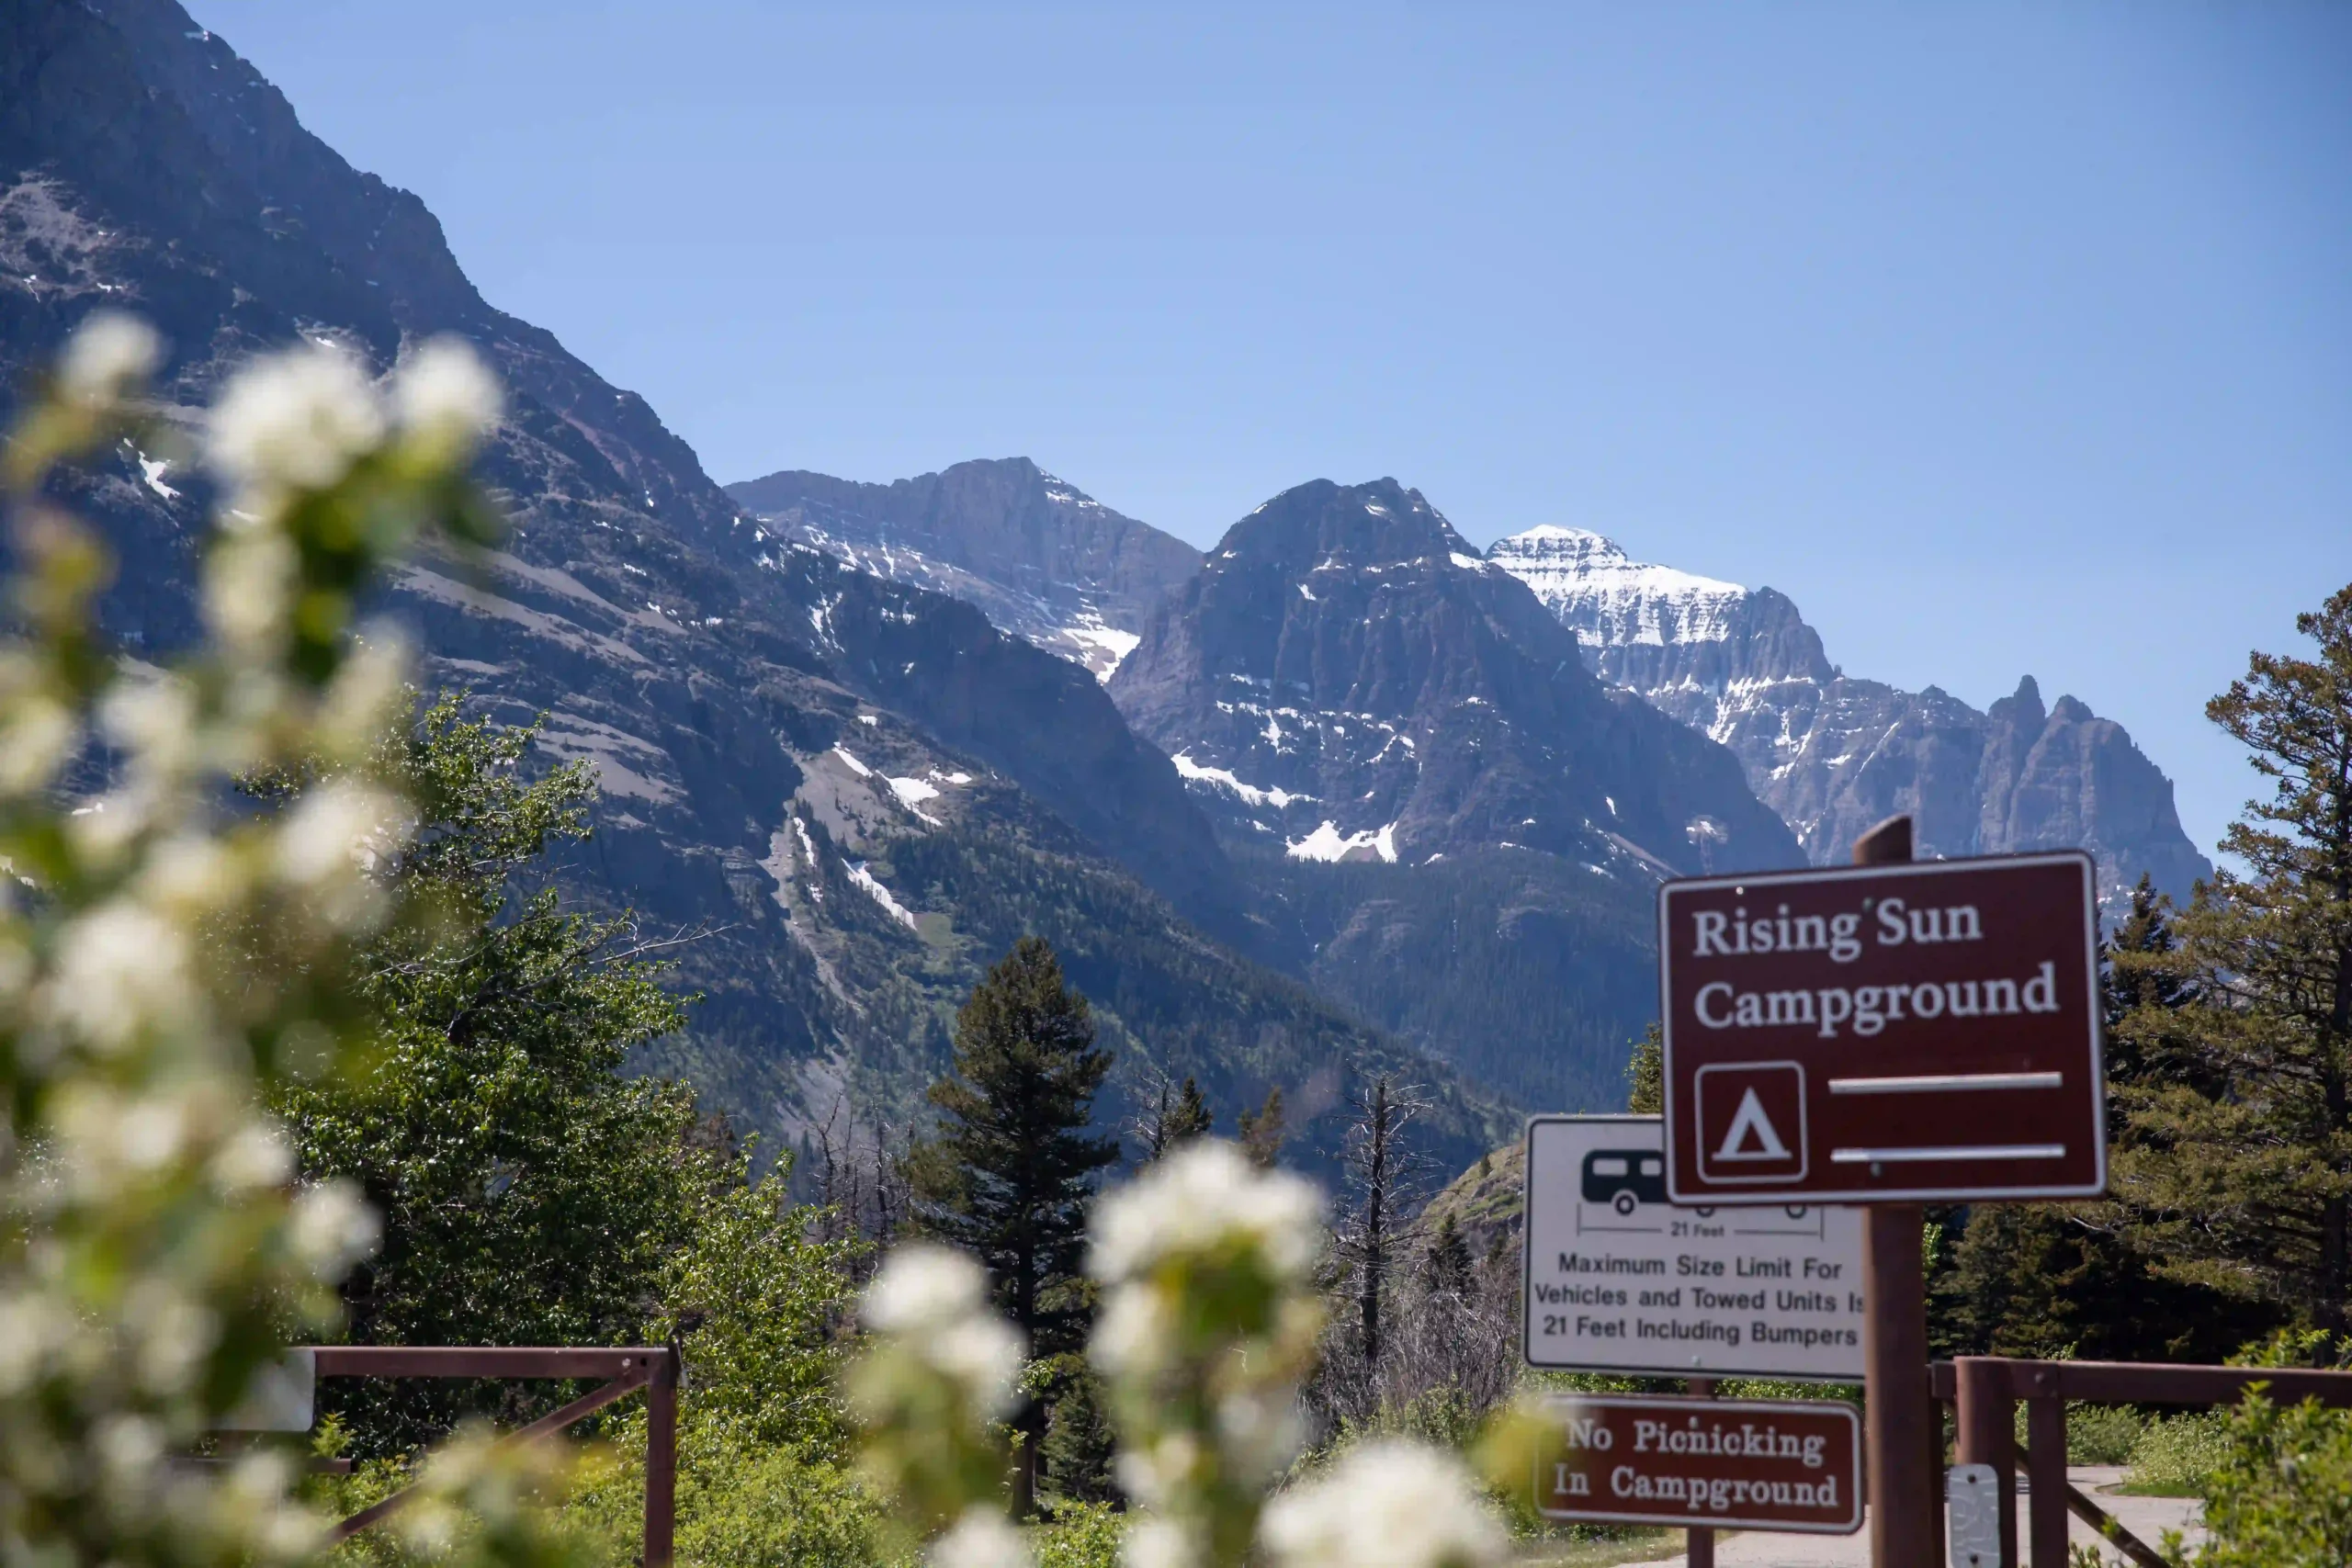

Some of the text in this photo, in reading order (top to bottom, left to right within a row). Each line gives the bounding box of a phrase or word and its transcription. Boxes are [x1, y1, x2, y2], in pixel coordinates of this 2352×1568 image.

[1692, 898, 1983, 963] Rising Sun
[1694, 961, 2060, 1038] Campground
[1671, 1222, 1724, 1237] 21 Feet
[1558, 1253, 1842, 1280] Maximum Size Limit For
[1535, 1284, 1627, 1306] Vehicles
[1638, 1287, 1680, 1307] and
[1690, 1288, 1765, 1310] Towed
[1777, 1290, 1837, 1313] Units
[1544, 1315, 1858, 1348] 21 Feet Including Bumpers
[1567, 1417, 1826, 1466] No Picnicking
[1554, 1464, 1838, 1510] In Campground
